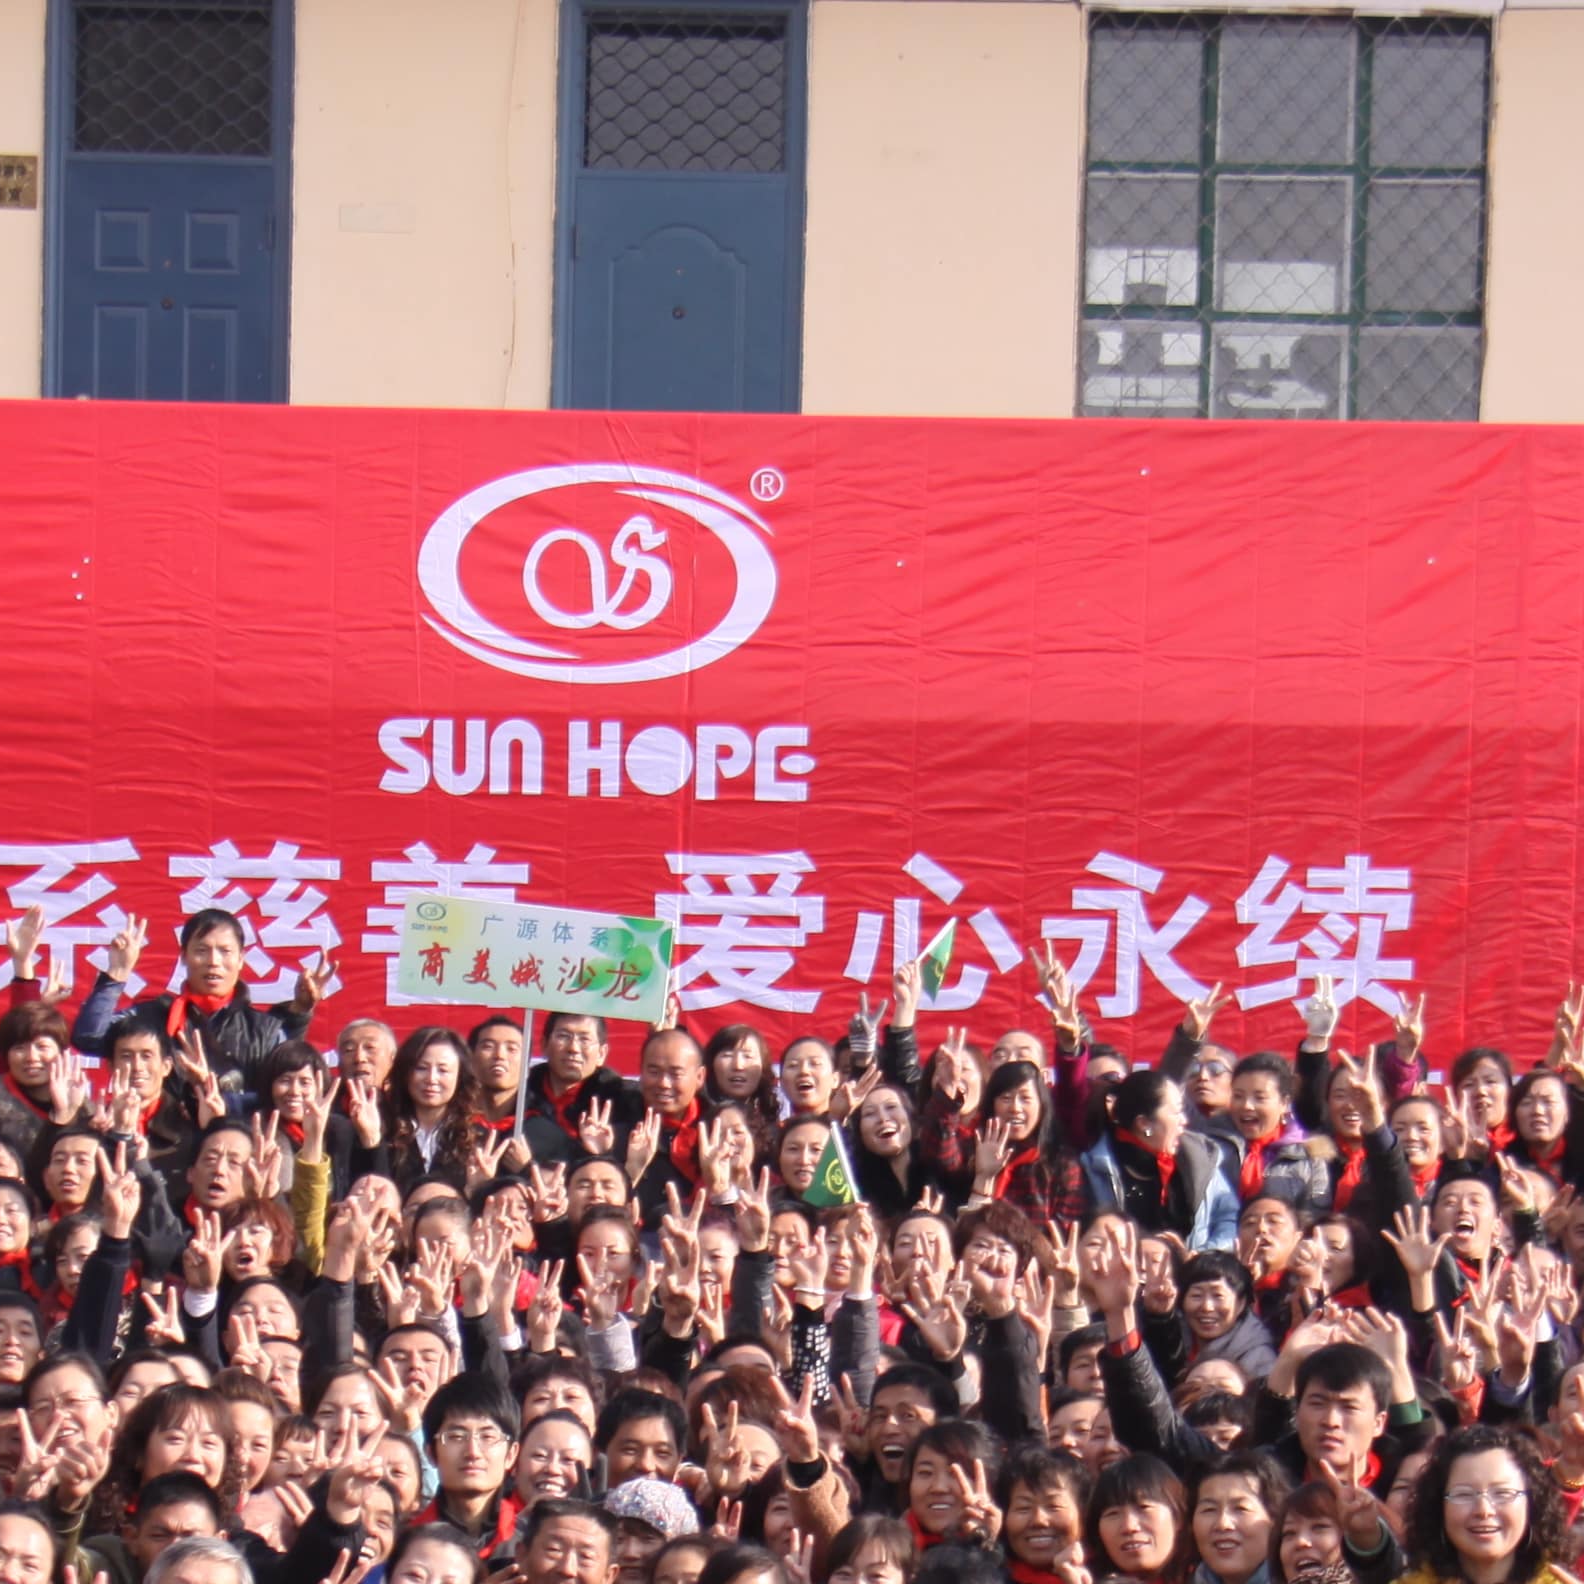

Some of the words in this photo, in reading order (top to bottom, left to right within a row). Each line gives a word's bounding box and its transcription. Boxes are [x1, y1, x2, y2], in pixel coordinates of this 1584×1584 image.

[378, 717, 544, 796] SUN
[567, 720, 818, 802] HOPE
[480, 914, 611, 947] 广源体系
[656, 850, 1415, 1020] 爱心永续
